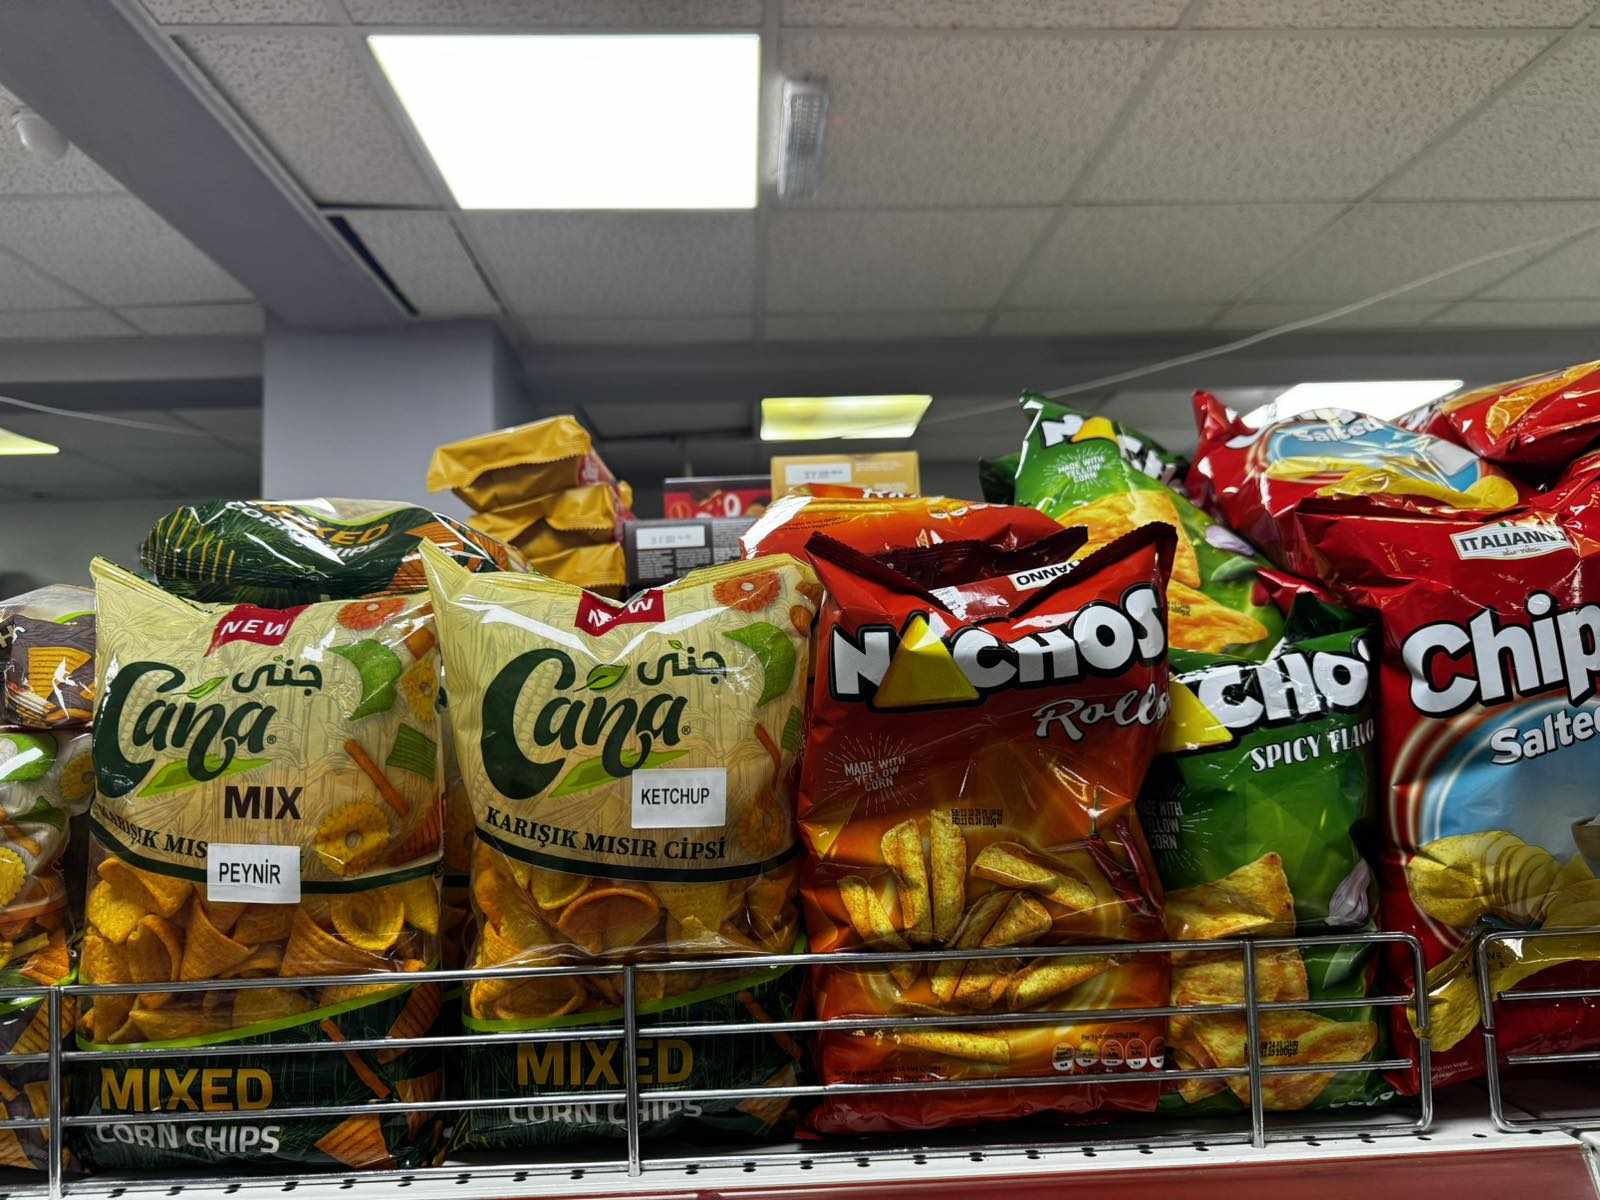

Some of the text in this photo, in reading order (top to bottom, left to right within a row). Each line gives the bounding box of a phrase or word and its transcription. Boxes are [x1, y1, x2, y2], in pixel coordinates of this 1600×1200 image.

[220, 618, 289, 637] NEW
[92, 661, 278, 799] Cana
[481, 647, 690, 800] Cana
[844, 756, 906, 777] MADE WITH
[1250, 734, 1321, 773] SPICY
[854, 767, 900, 786] YELLOW
[864, 776, 894, 792] CORN
[223, 786, 303, 820] MIX
[641, 787, 710, 806] KETCHUP
[164, 834, 209, 859] MIS
[485, 806, 728, 861] KARIŞIK MISIR CİPSİ
[219, 859, 281, 885] PEYNİR
[517, 1039, 694, 1086] MIXED
[100, 1068, 274, 1114] MIXED
[96, 1123, 281, 1154] CORN CHIPS
